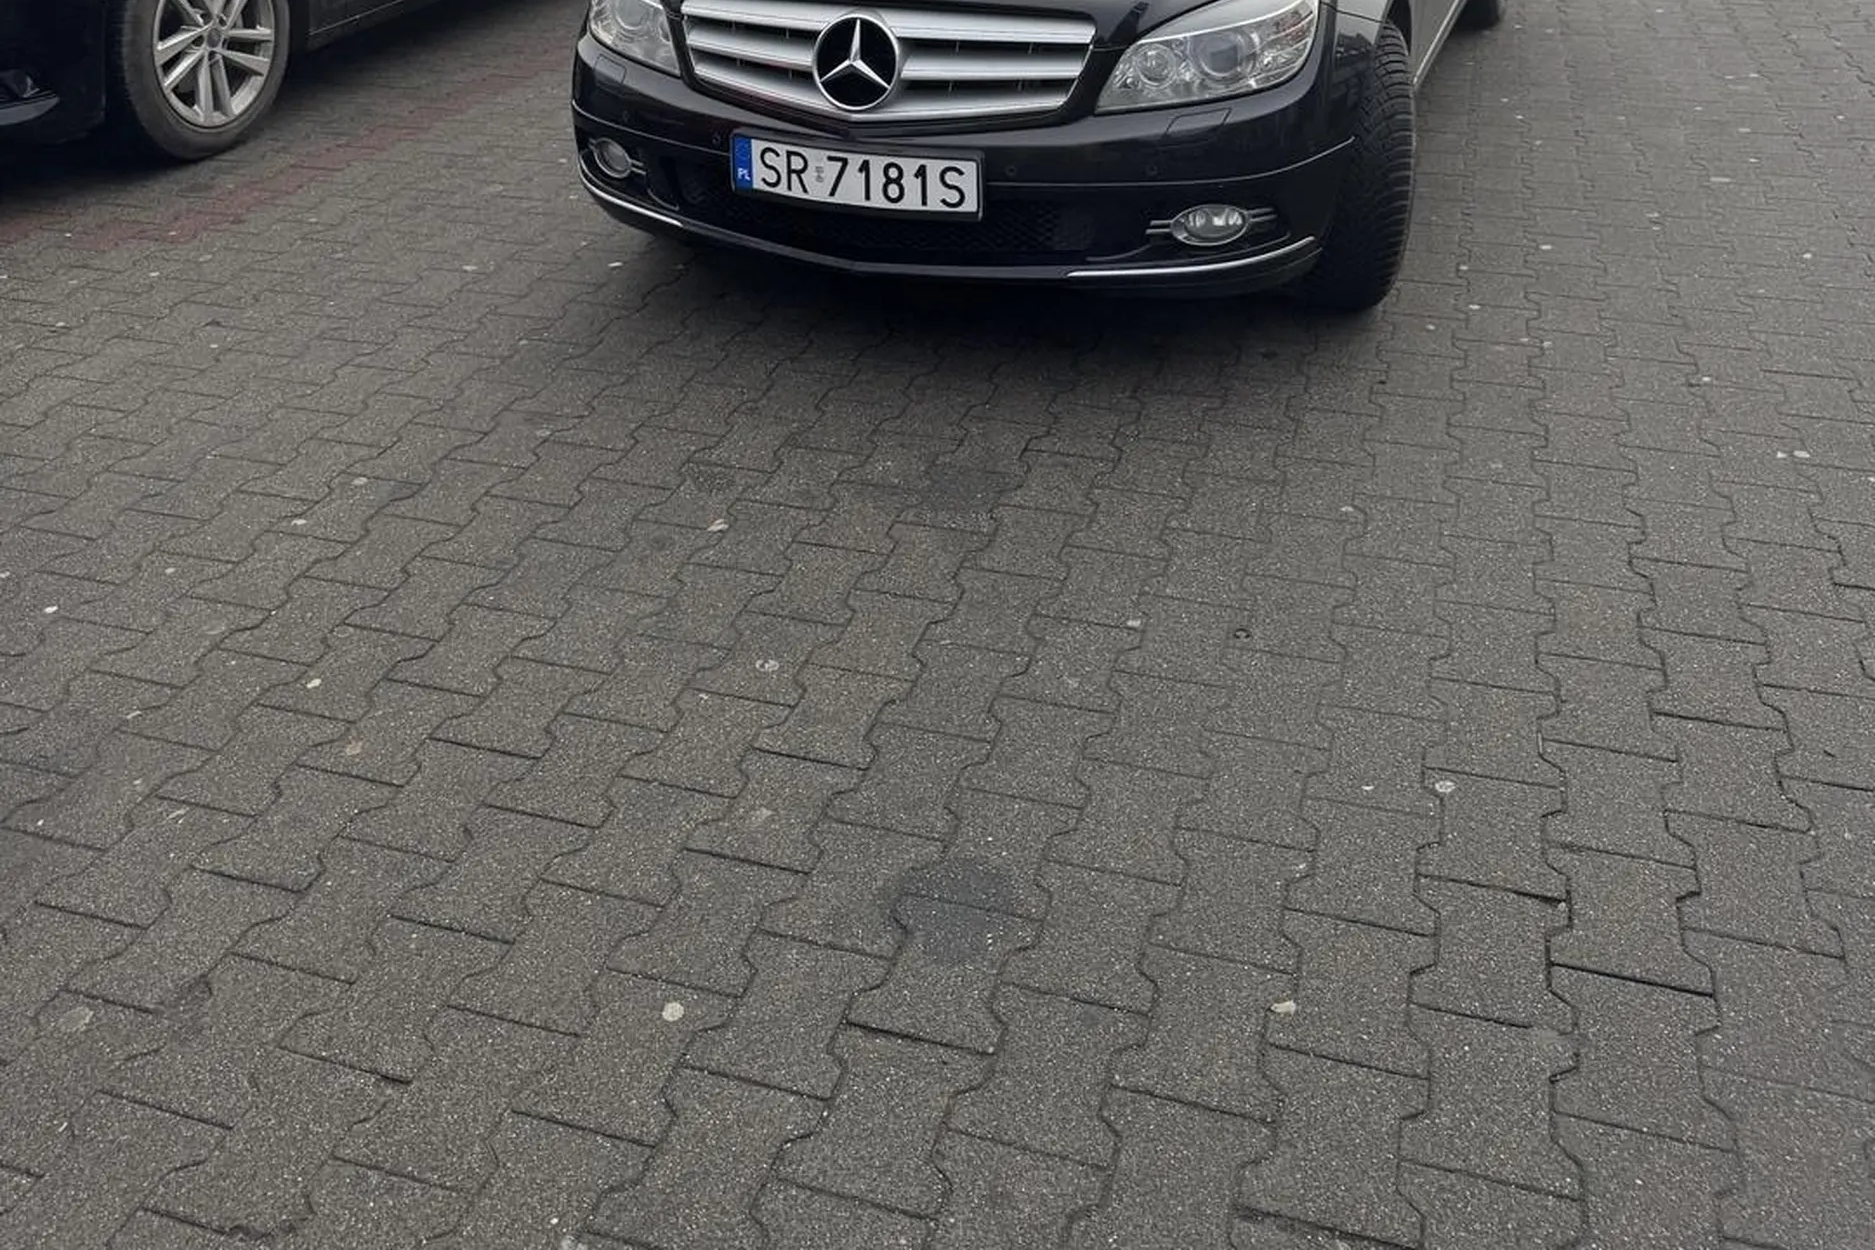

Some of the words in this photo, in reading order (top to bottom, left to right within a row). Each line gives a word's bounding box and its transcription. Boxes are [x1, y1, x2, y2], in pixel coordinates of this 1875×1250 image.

[737, 167, 751, 181] PL
[759, 146, 809, 195] SR
[826, 155, 967, 209] 7181S
